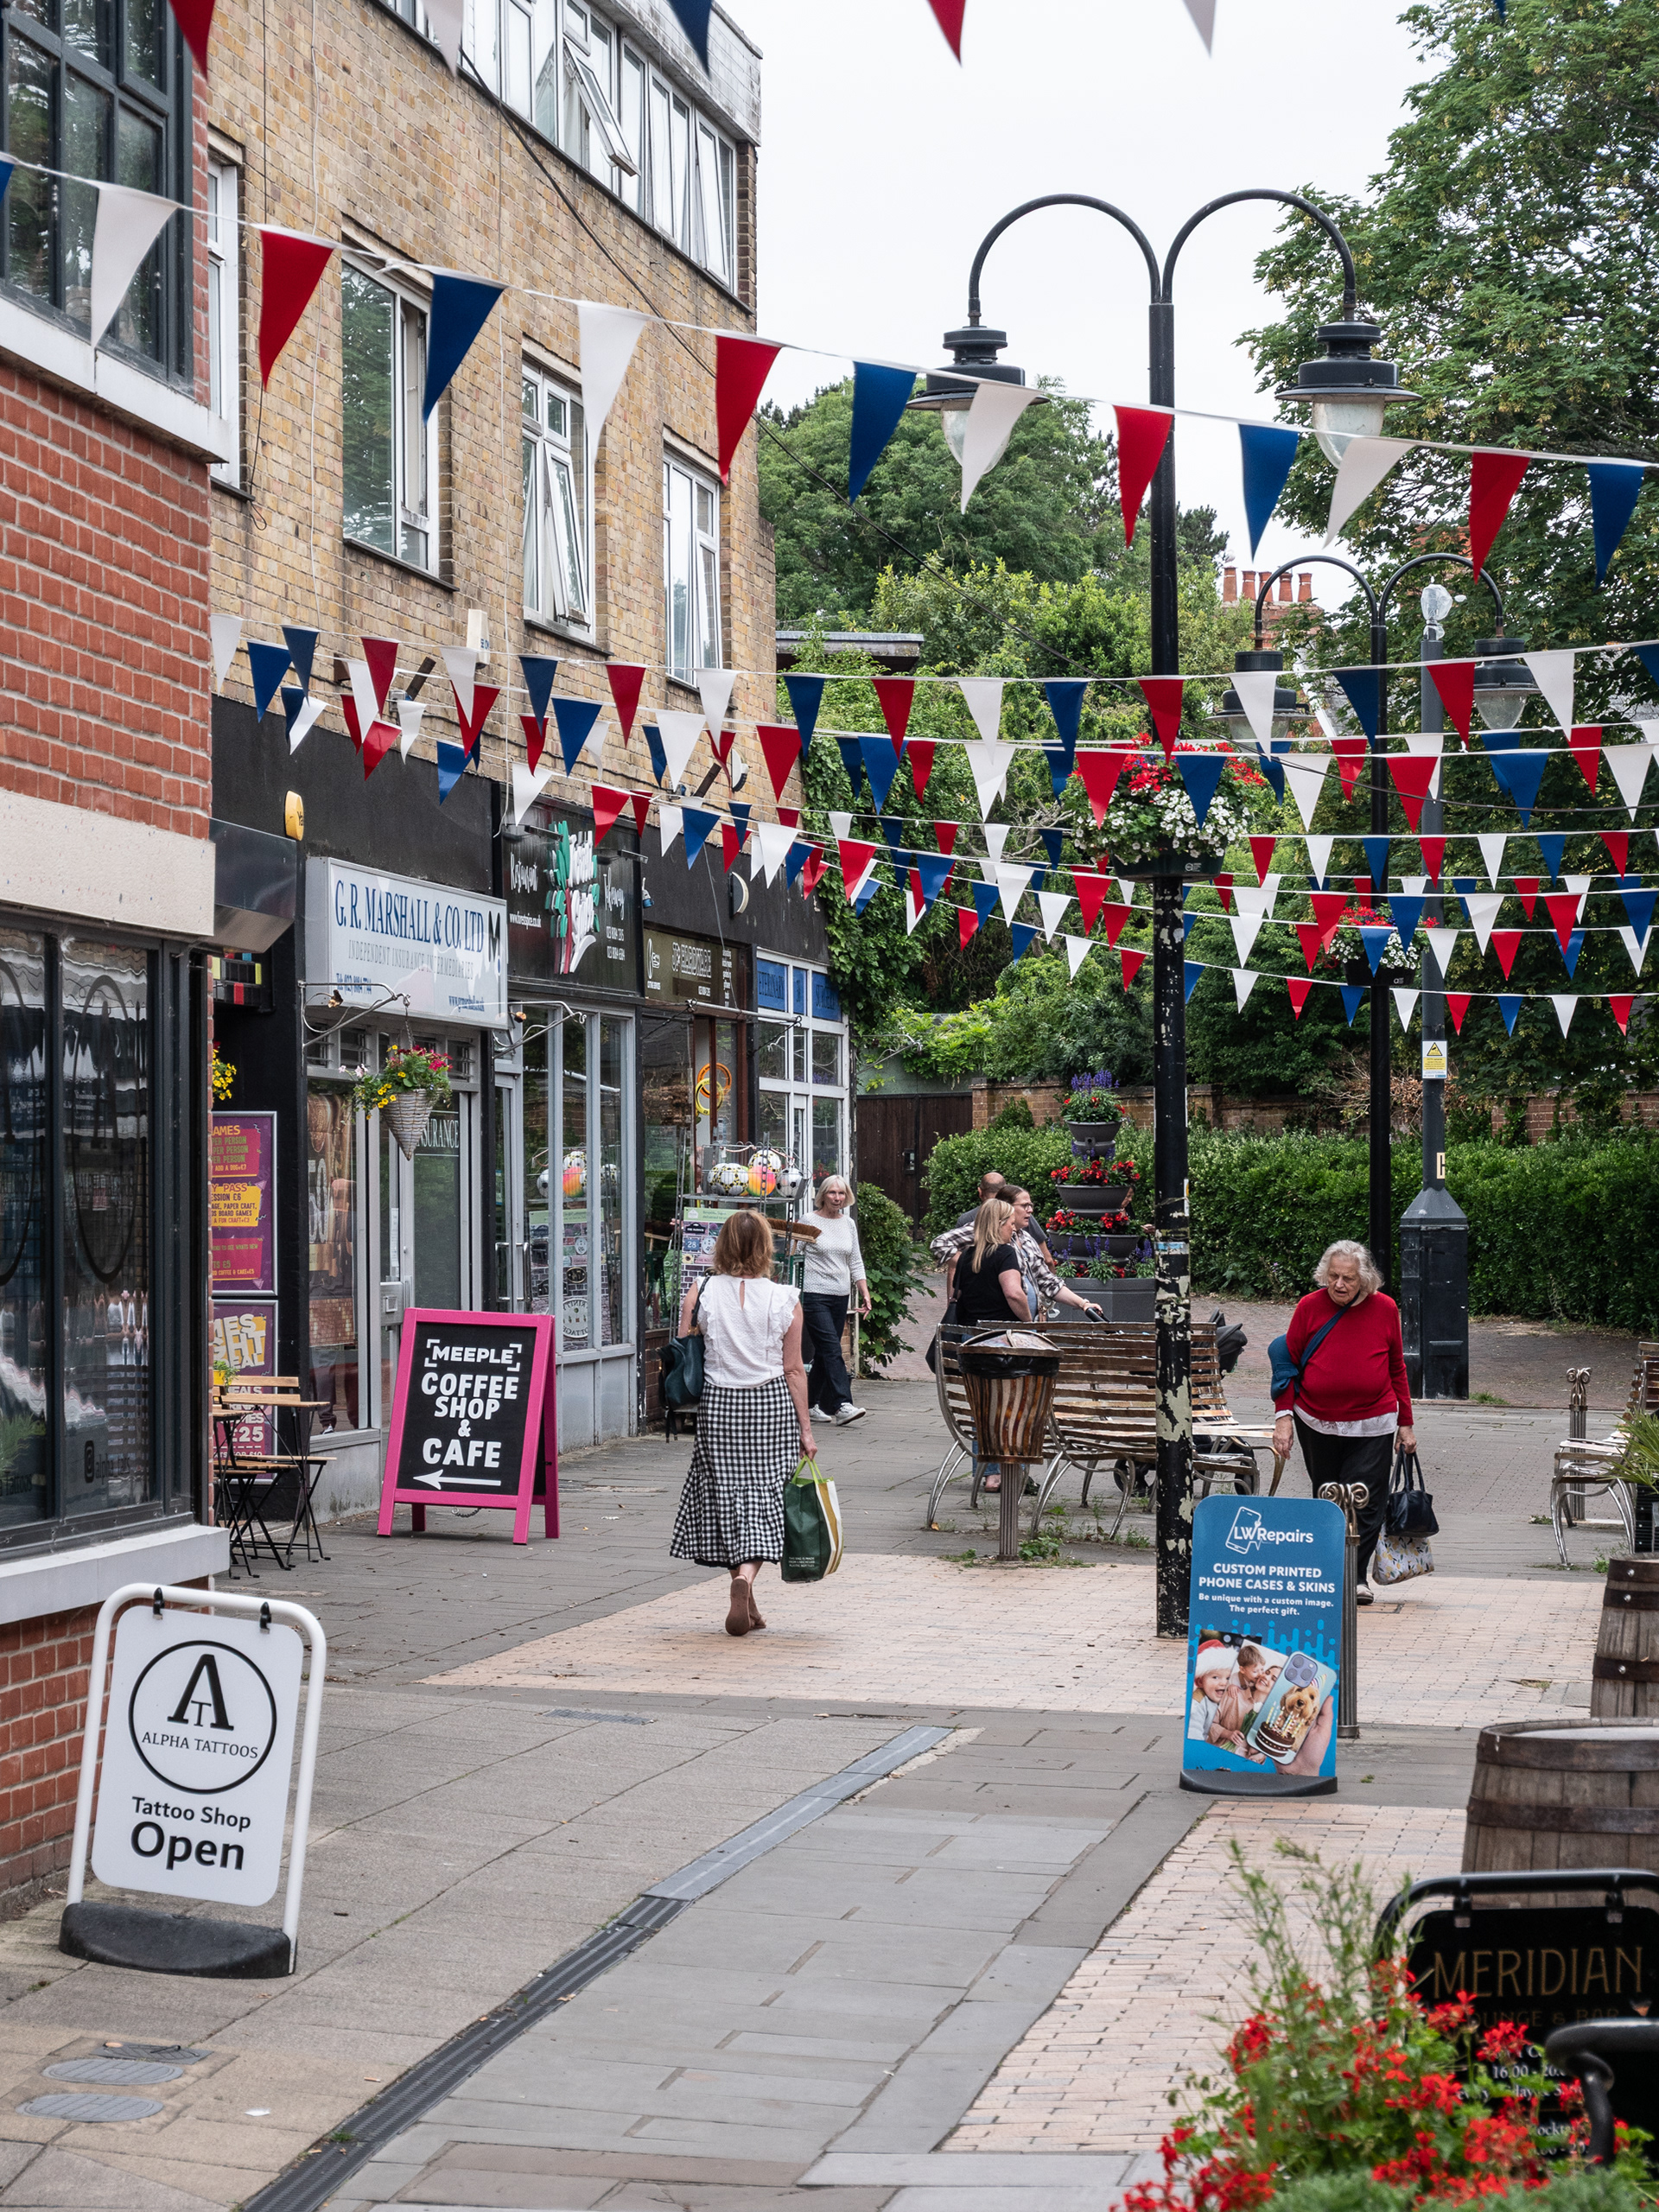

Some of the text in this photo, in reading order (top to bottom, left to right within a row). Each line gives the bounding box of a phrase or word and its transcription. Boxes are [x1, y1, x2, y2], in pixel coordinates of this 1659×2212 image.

[335, 880, 484, 953] G. R. MARSHALL & CO. LTD
[348, 939, 391, 966] INDEPENDENT
[392, 949, 427, 972] INSURANCE
[213, 1125, 241, 1136] AMES
[225, 1136, 247, 1145] PERSON
[213, 1145, 249, 1155] PER PERSON
[223, 1154, 245, 1164] PERSON
[223, 1182, 248, 1192] PASS
[432, 1345, 514, 1363] MEEPLE
[421, 1372, 519, 1400] COFFEE
[434, 1396, 500, 1420] SHOP
[458, 1419, 471, 1437] &
[423, 1438, 501, 1468] CAFE
[1212, 1563, 1322, 1578] CUSTOM PRINTED
[1198, 1577, 1336, 1593] PHONE CASES & SKINS
[1198, 1592, 1210, 1601] Be
[1211, 1593, 1242, 1604] unique
[1243, 1595, 1262, 1604] with
[1271, 1598, 1303, 1606] custom
[1305, 1598, 1334, 1608] image.
[1229, 1605, 1300, 1617] The perfect gift.
[142, 1732, 258, 1759] ALPHA TATTOOS
[131, 1796, 251, 1833] Tattoo Shop
[130, 1821, 245, 1871] Open
[1433, 1947, 1643, 1999] MERIDIAN
